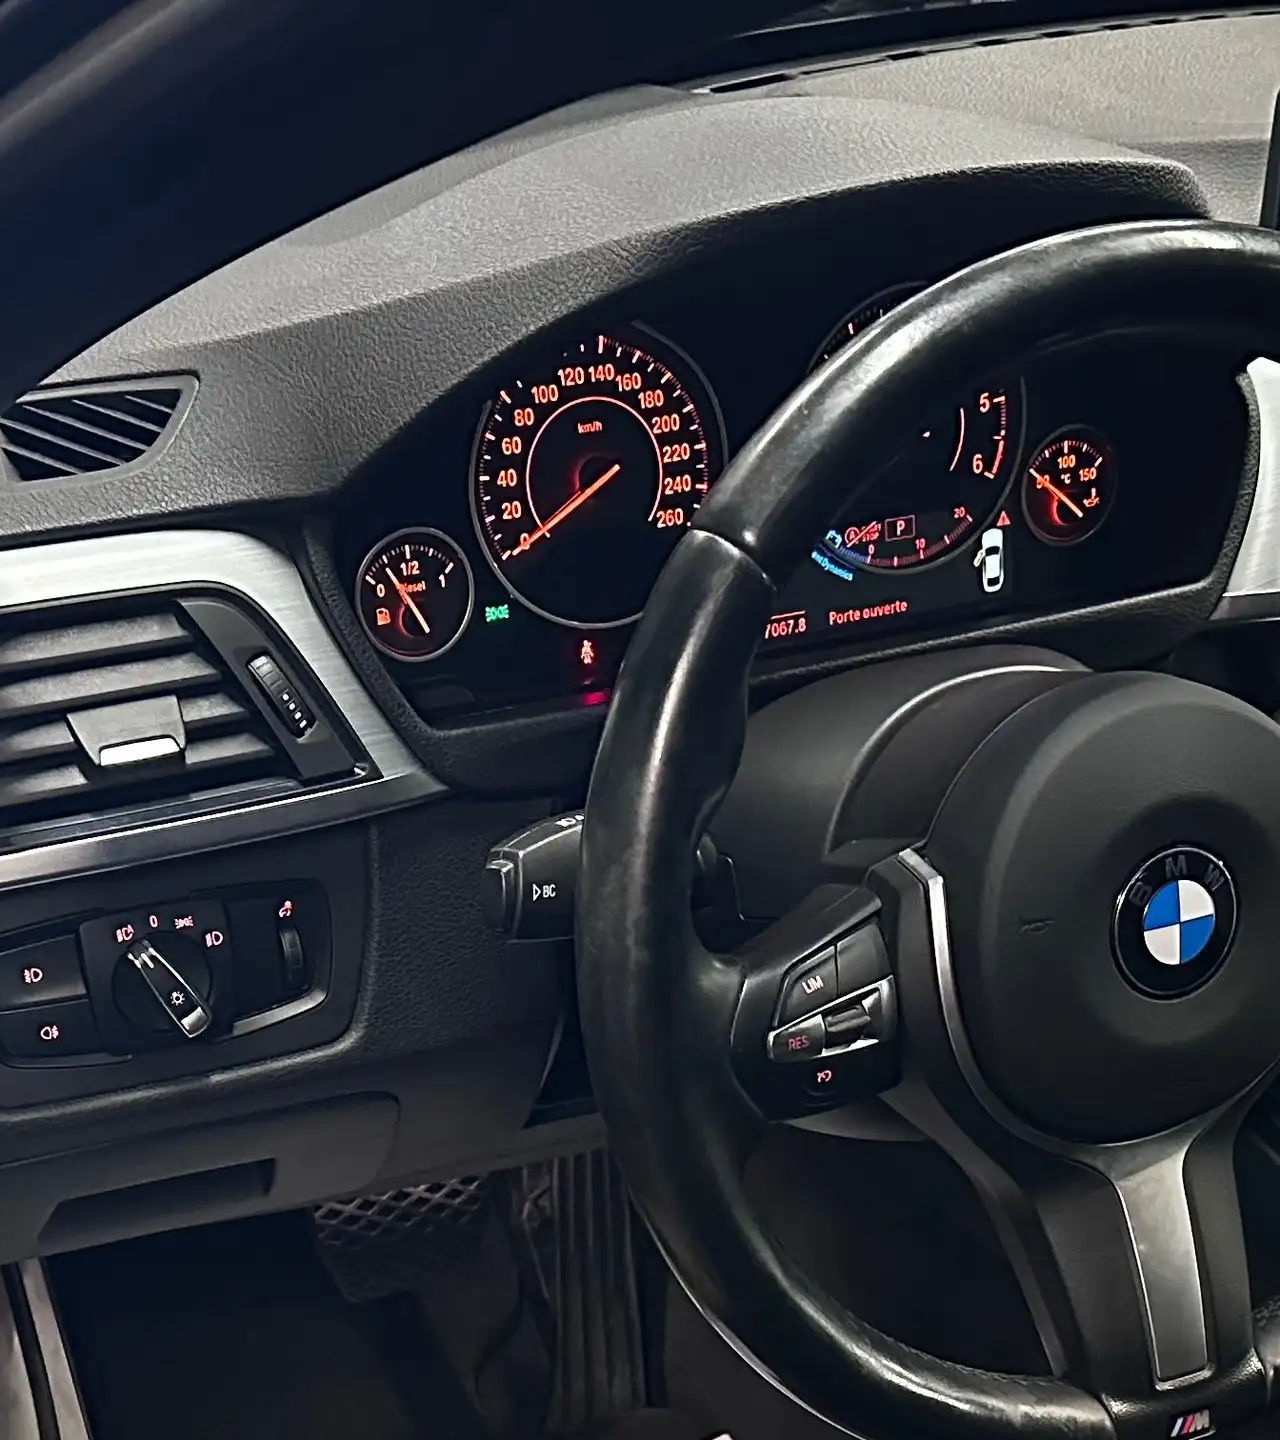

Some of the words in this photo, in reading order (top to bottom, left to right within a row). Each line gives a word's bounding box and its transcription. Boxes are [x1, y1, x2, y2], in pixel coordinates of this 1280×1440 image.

[557, 366, 585, 386] 120
[588, 364, 615, 383] 140
[615, 372, 642, 392] 160
[531, 384, 559, 404] 100
[638, 389, 664, 409] 180
[979, 392, 991, 413] 5
[513, 407, 535, 426] 80
[651, 413, 680, 434] 200
[577, 420, 603, 434] km/h
[501, 436, 522, 455] 60
[662, 443, 690, 463] 220
[972, 453, 984, 474] 6
[1057, 454, 1076, 469] 100
[496, 468, 518, 487] 40
[1079, 467, 1097, 482] 150
[664, 474, 692, 495] 240
[501, 500, 522, 519] 20
[656, 508, 684, 528] 260
[953, 506, 966, 518] 20
[896, 520, 906, 537] P
[868, 544, 875, 555] 0
[915, 538, 926, 549] 10
[400, 560, 420, 576] 1/2
[376, 583, 386, 598] 0
[438, 574, 446, 588] 1
[829, 609, 861, 626] Porte
[862, 600, 909, 620] ouverte
[1127, 853, 1226, 907] BMW
[542, 883, 556, 899] BC
[802, 976, 823, 994] LIM
[787, 1036, 810, 1052] RES
